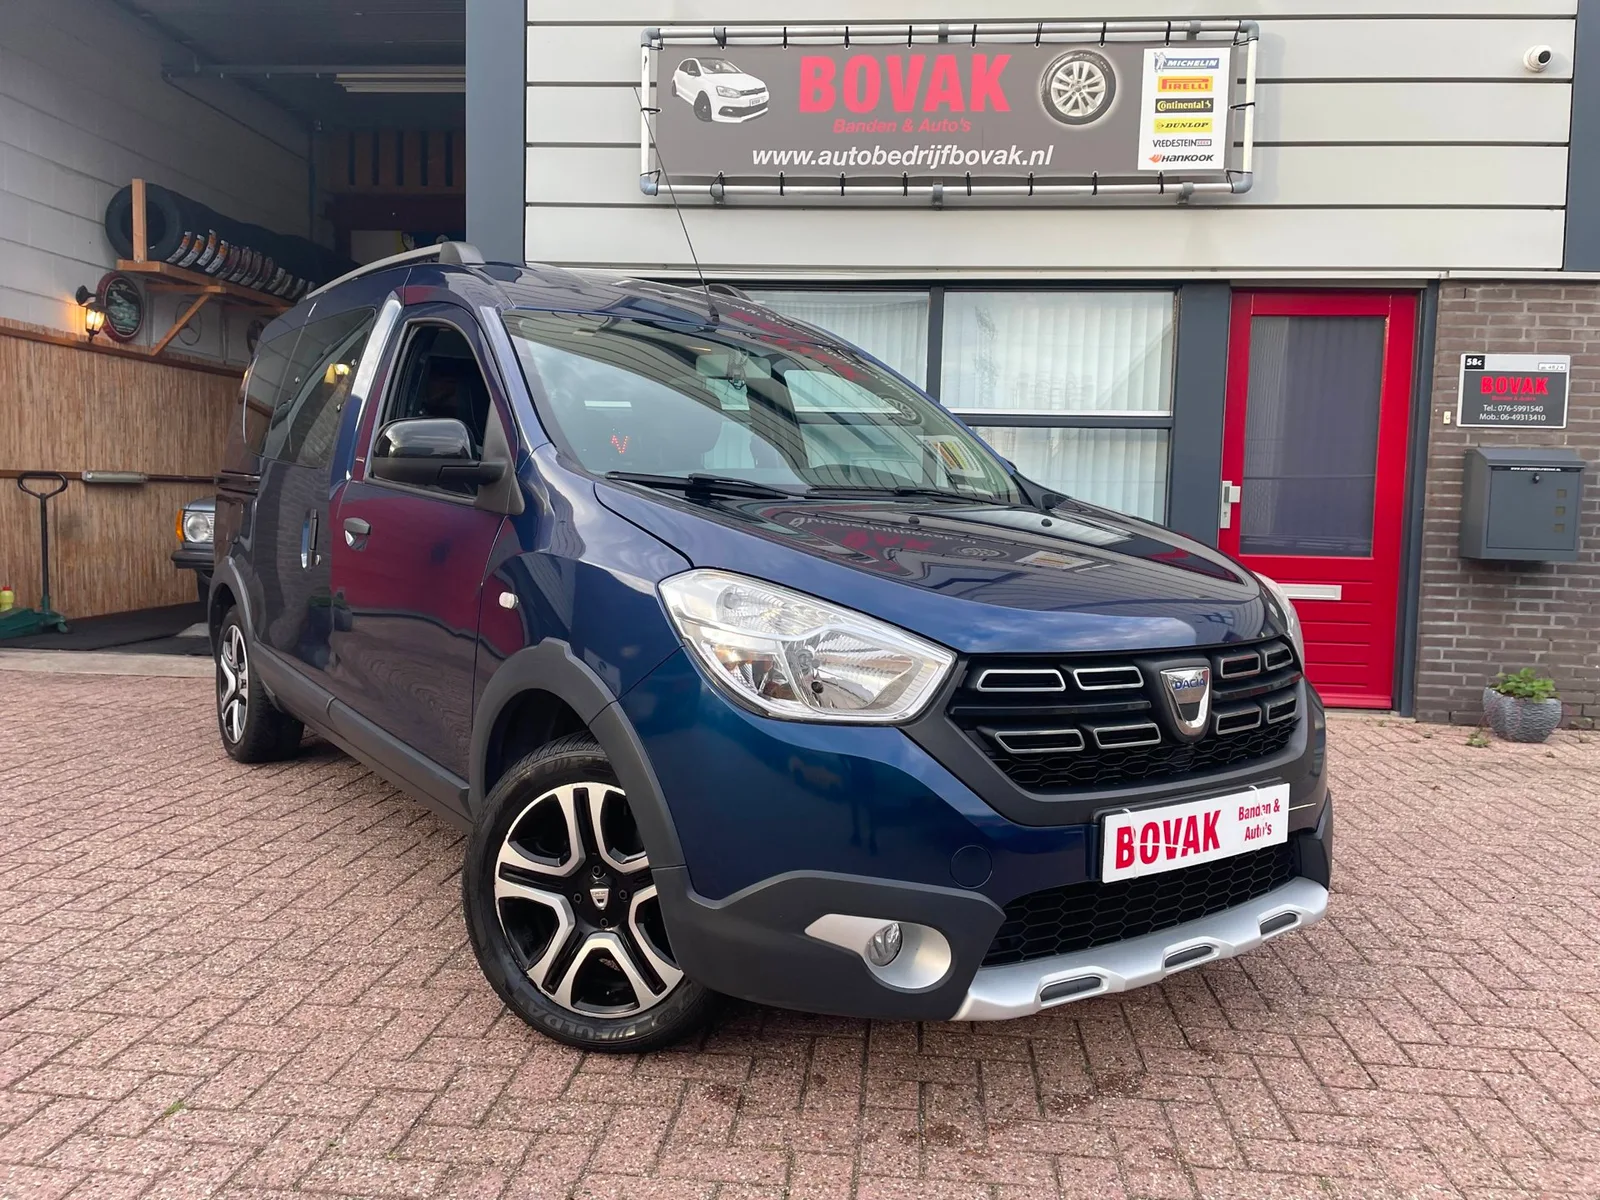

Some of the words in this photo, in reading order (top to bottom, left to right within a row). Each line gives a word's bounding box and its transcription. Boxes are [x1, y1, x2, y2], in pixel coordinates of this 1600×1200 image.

[1167, 59, 1218, 67] MICHELIN
[799, 54, 1012, 114] BOVAK
[1162, 78, 1209, 90] PIRELLI
[1157, 100, 1204, 112] Continental
[833, 118, 897, 133] Banden
[902, 118, 914, 133] &
[918, 117, 972, 133] Auto's
[1152, 139, 1197, 148] VREDESTEIN
[752, 145, 1054, 169] www.autobedrijfbovak.nl
[1466, 358, 1483, 366] 58c
[1480, 375, 1549, 395] BOVAK
[1500, 414, 1546, 422] 06-49313410
[1175, 678, 1206, 690] DACIA
[1273, 798, 1281, 813] &
[1115, 809, 1222, 870] BOVAK
